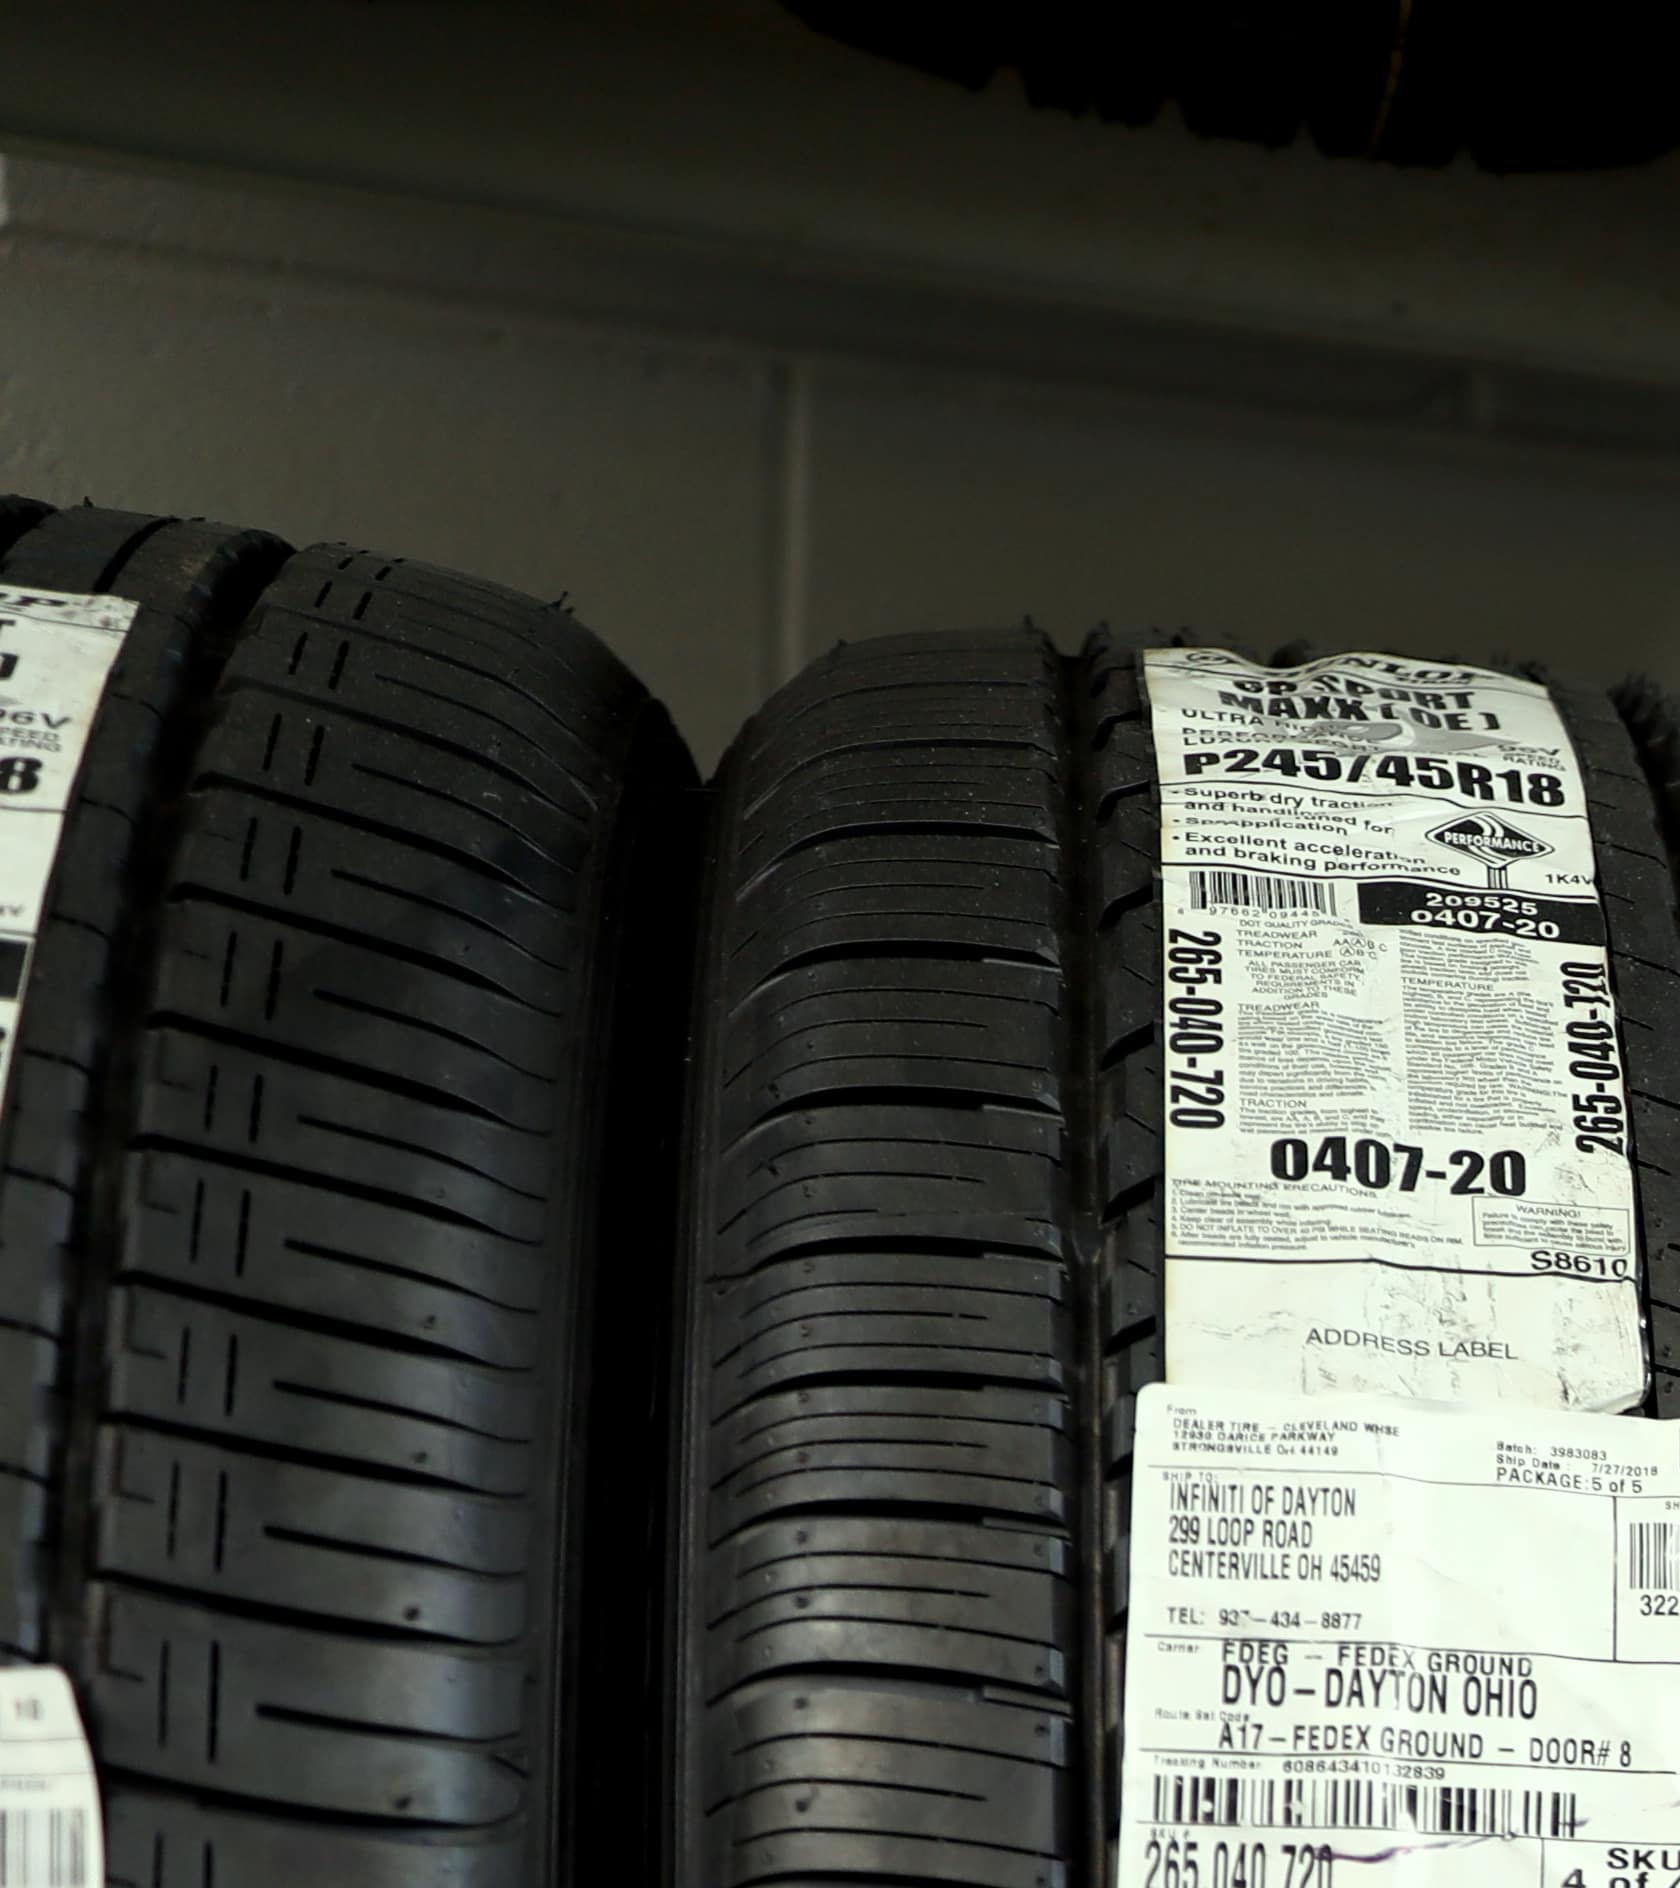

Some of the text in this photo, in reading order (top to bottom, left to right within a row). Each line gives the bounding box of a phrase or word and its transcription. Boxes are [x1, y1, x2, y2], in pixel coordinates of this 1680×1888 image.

[1182, 708, 1264, 726] ULTRA
[1217, 691, 1369, 721] MAXX
[1184, 749, 1565, 807] P245/45R18
[1184, 786, 1394, 810] Superb dry traction
[1184, 801, 1225, 812] and
[1364, 819, 1393, 836] for
[1184, 831, 1287, 850] Excellent
[1444, 831, 1546, 853] PERFORMANCE
[1185, 847, 1461, 877] and braking performance
[1425, 892, 1539, 916] 209525
[1237, 929, 1318, 939] TREADWEAR
[1411, 908, 1561, 939] 0407-20
[1237, 939, 1303, 949] TRACTION
[1237, 949, 1333, 959] TEMPERATURE
[1401, 976, 1495, 991] TEMPERATURE
[1237, 1001, 1320, 1012] TREADWEAR
[1168, 928, 1225, 1130] 265-040-720
[1559, 961, 1627, 1157] 265-040-720
[1240, 1098, 1308, 1109] TRACTION
[1270, 1136, 1526, 1197] 0407-20
[1282, 1183, 1378, 1199] PRECAUTIONS
[1515, 1204, 1581, 1219] WARNING!
[1530, 1250, 1628, 1278] S8610
[1305, 1327, 1519, 1361] ADDRESS LABEL
[1173, 1418, 1358, 1433] DEALER TIRE CLEVELAND
[1217, 1431, 1336, 1443] DARICE PARKWAY
[1172, 1441, 1339, 1456] STRONGSVILLE 44149
[1549, 1445, 1608, 1461] 3983083
[1496, 1453, 1659, 1477] Ship Date 7/27/2018
[1608, 1479, 1626, 1494] of
[1631, 1479, 1643, 1494] 5
[1169, 1482, 1356, 1517] INFINITI OF DAYTON
[1168, 1514, 1314, 1549] 299 LOOP ROAD
[1168, 1548, 1382, 1583] CENTERVILLE OH 45459
[1167, 1606, 1205, 1626] TEL:
[1221, 1638, 1534, 1678] FDEG FEDEX GROUND
[1221, 1663, 1538, 1721] DYO DAYTON OHIO
[1218, 1721, 1632, 1768] A17 FEDEX GROUND DOOR# 8
